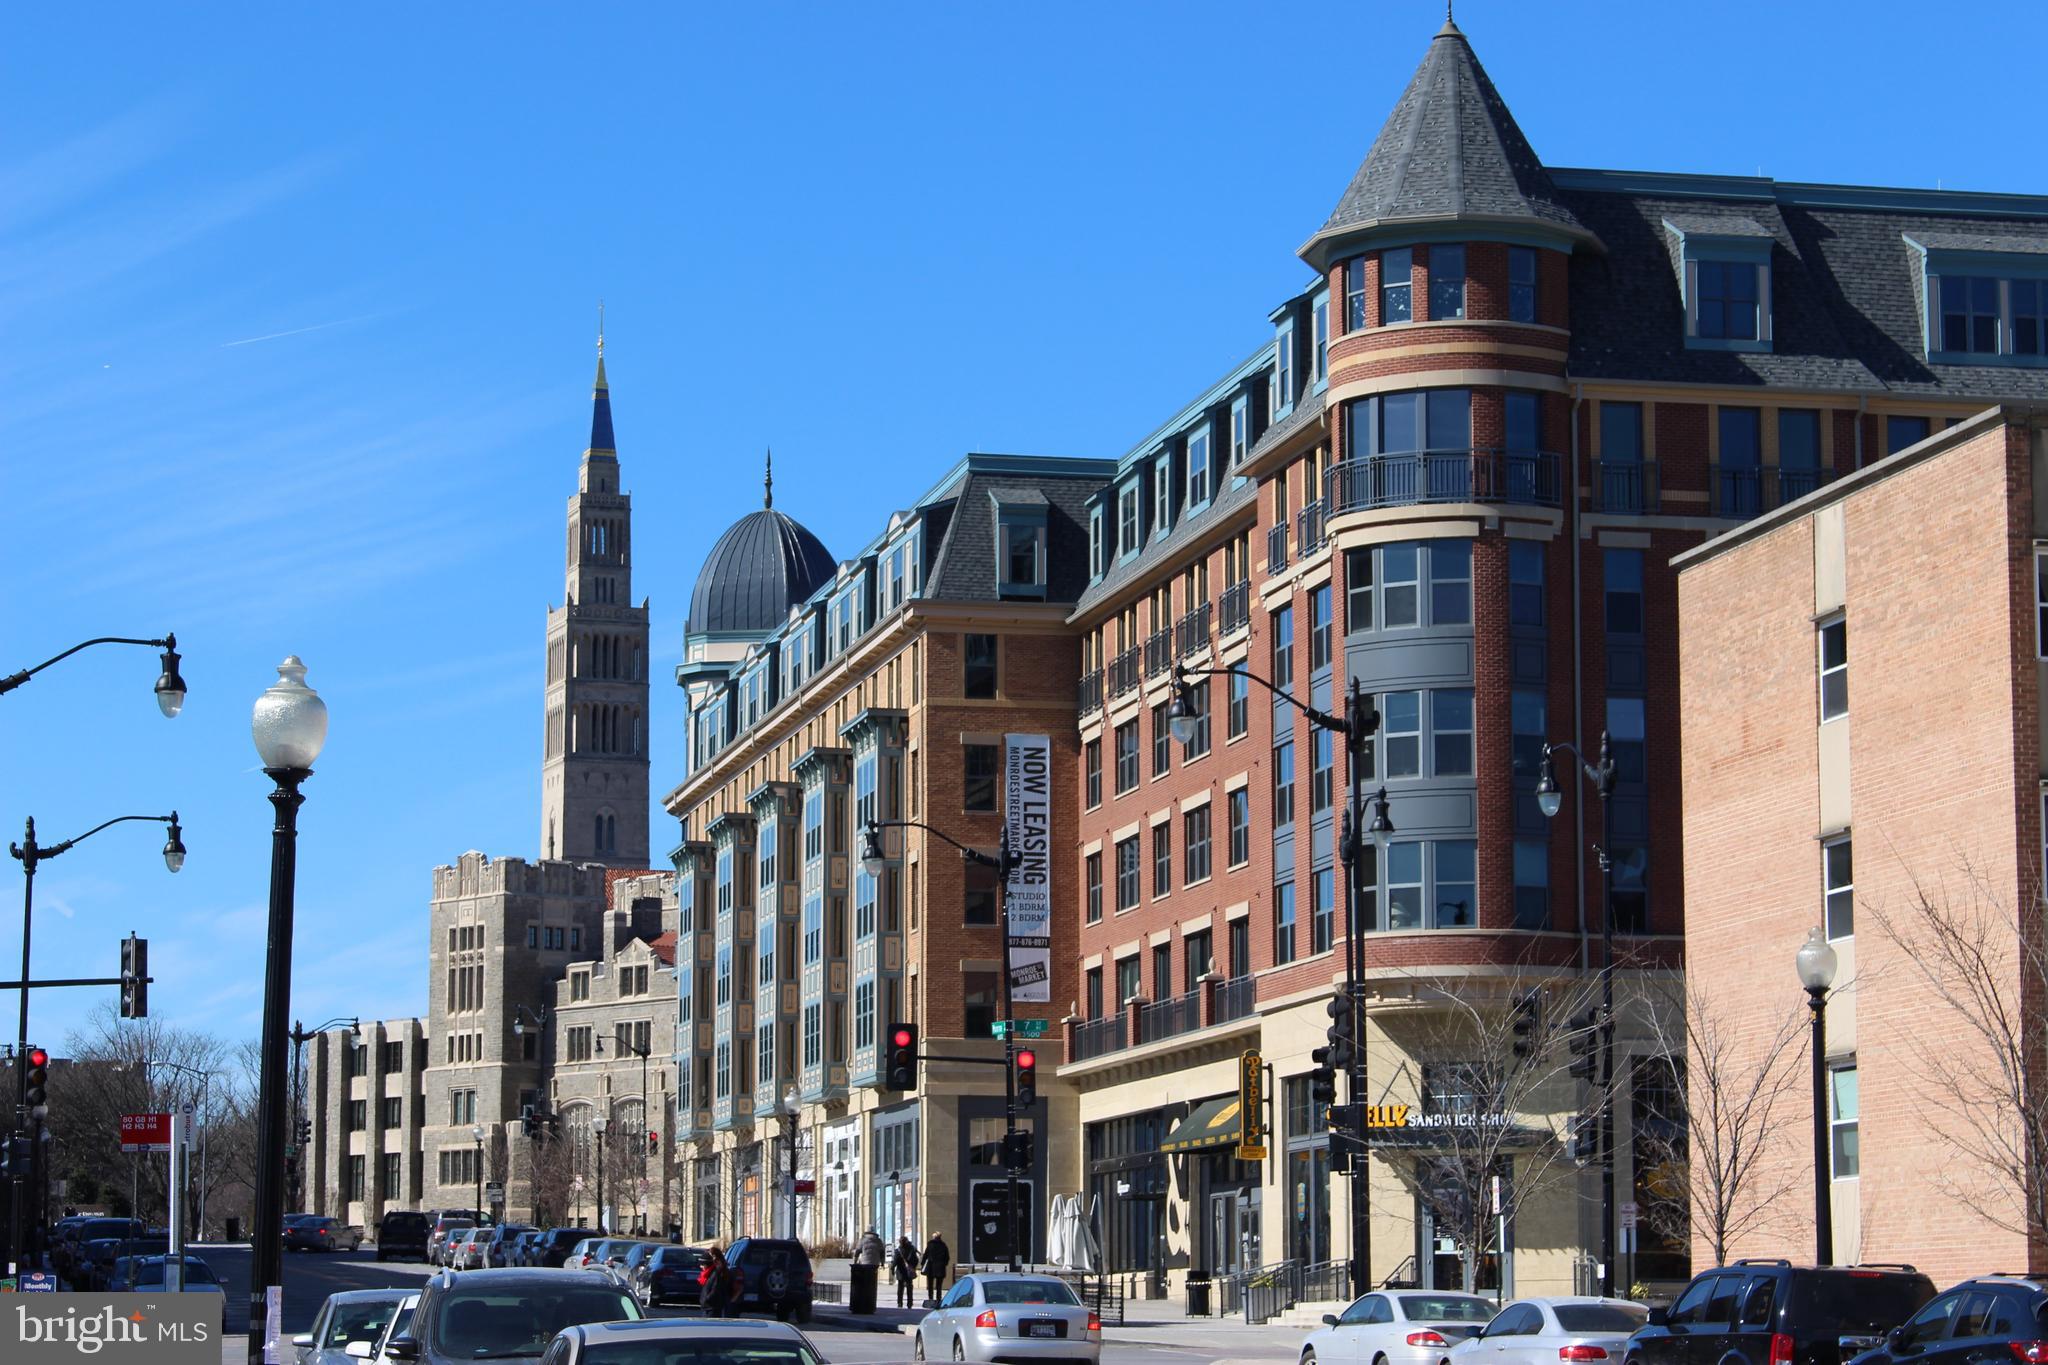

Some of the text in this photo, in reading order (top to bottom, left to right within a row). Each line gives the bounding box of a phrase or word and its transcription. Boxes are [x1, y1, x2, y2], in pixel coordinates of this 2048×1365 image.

[1023, 747, 1047, 885] NOW LEASING
[1011, 892, 1046, 901] STUDIO
[1019, 903, 1045, 911] BDRM
[1011, 913, 1045, 922] 2 BDRM
[1010, 966, 1038, 978] MONROE
[1018, 971, 1046, 985] MARKET
[1024, 1021, 1030, 1030] 7
[24, 1282, 52, 1290] Monthly
